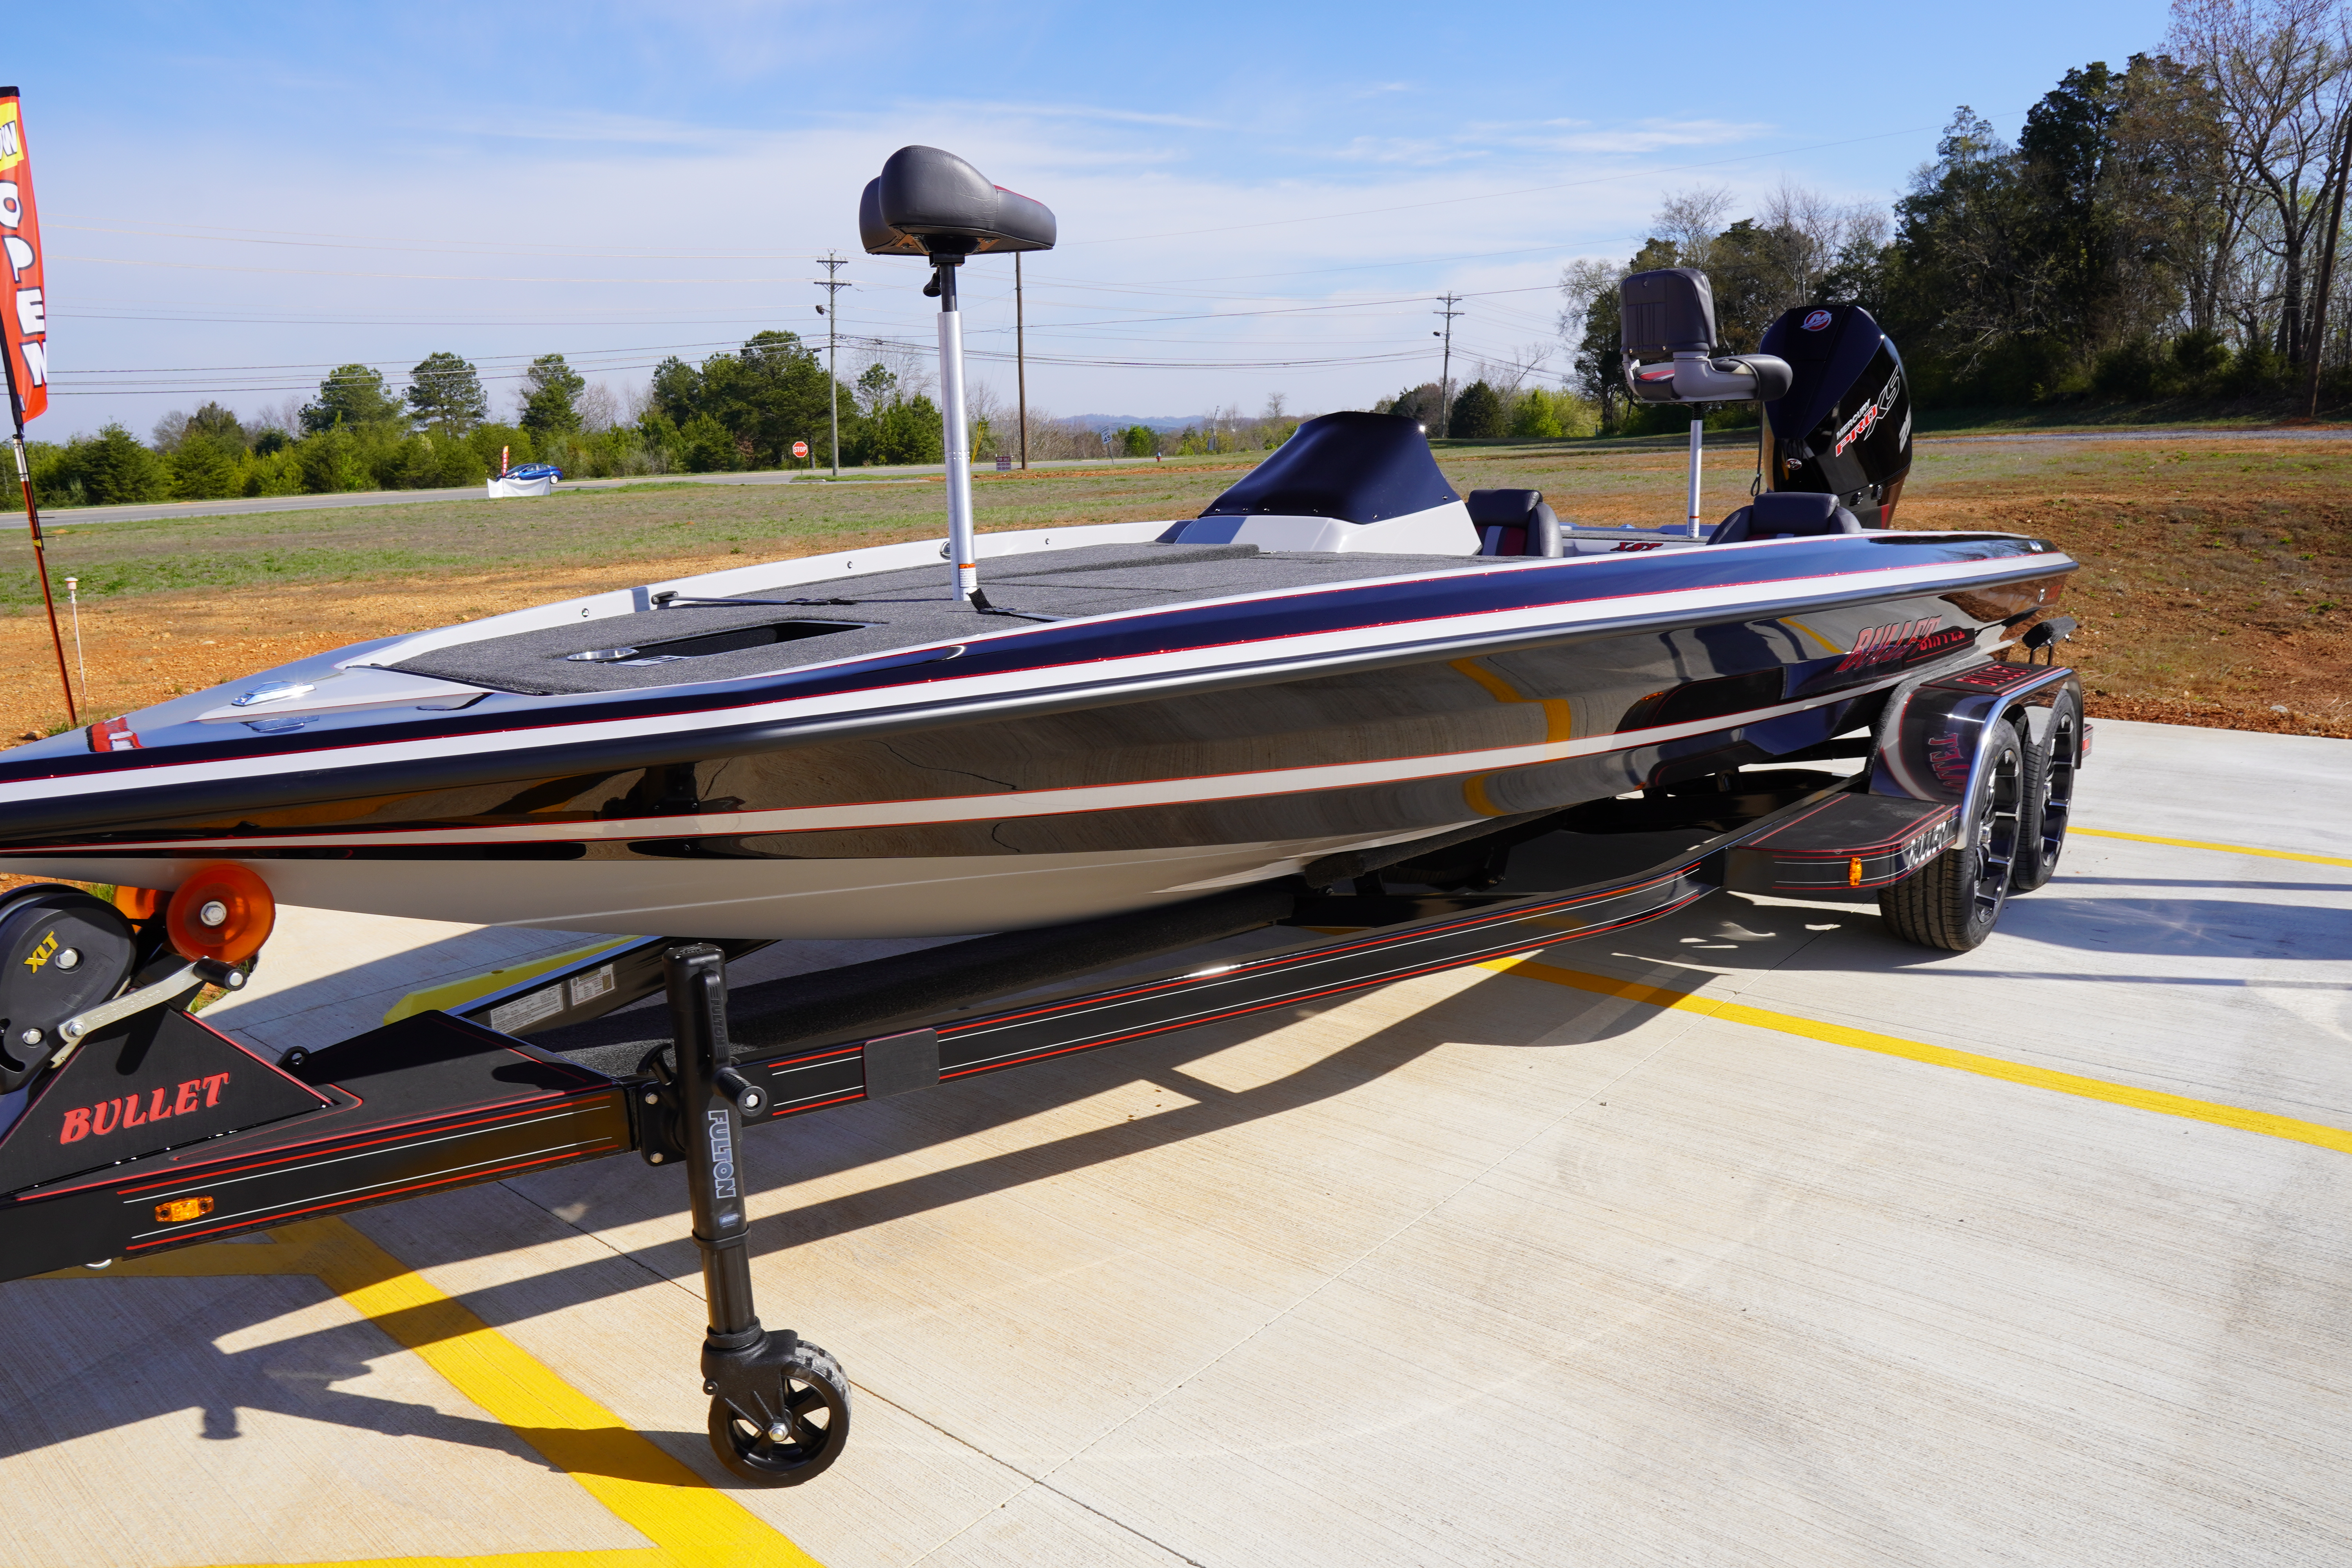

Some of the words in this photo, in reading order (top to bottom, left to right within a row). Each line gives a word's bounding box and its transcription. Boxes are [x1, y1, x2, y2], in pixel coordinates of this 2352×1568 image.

[0, 180, 47, 388] OPEN
[1835, 404, 1878, 457] PRO
[1836, 398, 1871, 440] MERCURY
[1833, 614, 1943, 674] BULLET
[1955, 665, 2033, 686] BULLET
[1907, 820, 1947, 870] BULLET
[23, 931, 59, 974] XLT
[711, 998, 726, 1045] FULTON
[60, 1072, 230, 1145] BULLET
[708, 1109, 737, 1199] FULTON
